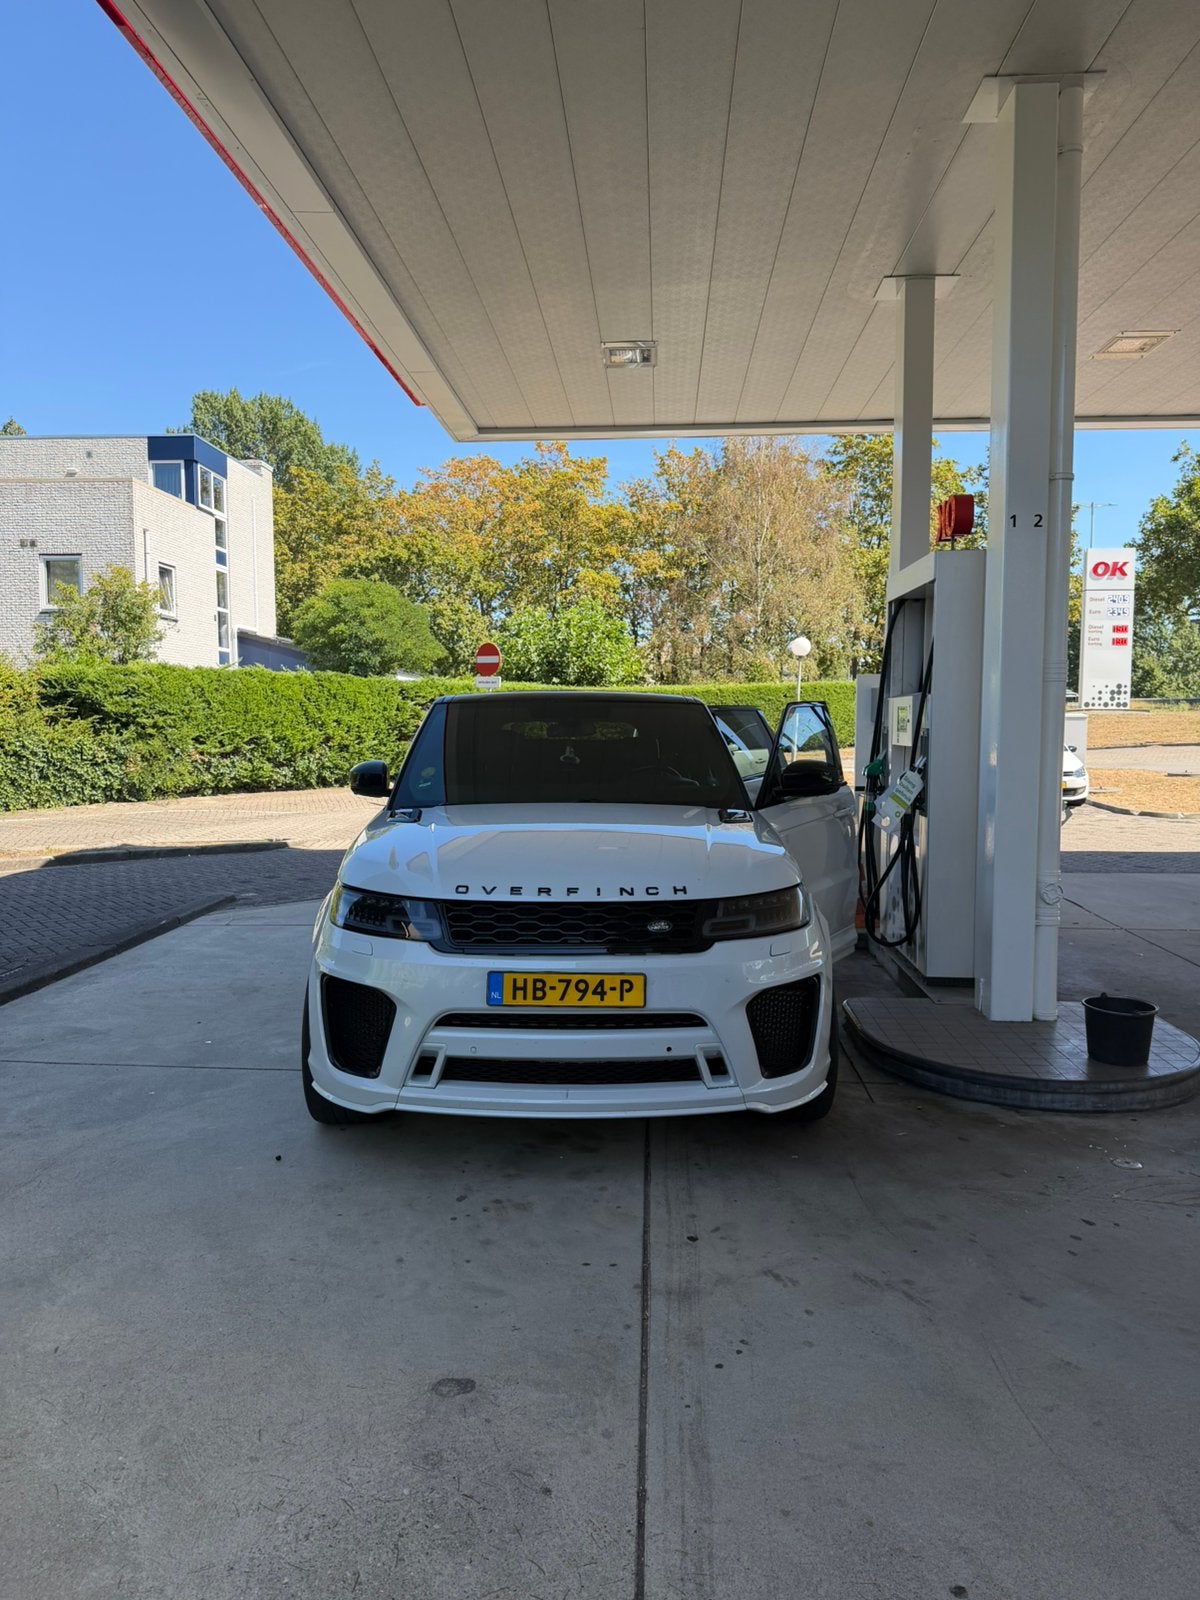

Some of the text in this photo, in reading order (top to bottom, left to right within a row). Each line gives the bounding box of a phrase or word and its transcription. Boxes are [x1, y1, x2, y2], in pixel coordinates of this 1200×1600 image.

[1010, 514, 1043, 528] 1 2
[1091, 561, 1130, 579] OK
[455, 884, 688, 897] OVERFINCH
[490, 991, 502, 999] NL
[512, 977, 635, 1002] HB-794-P
